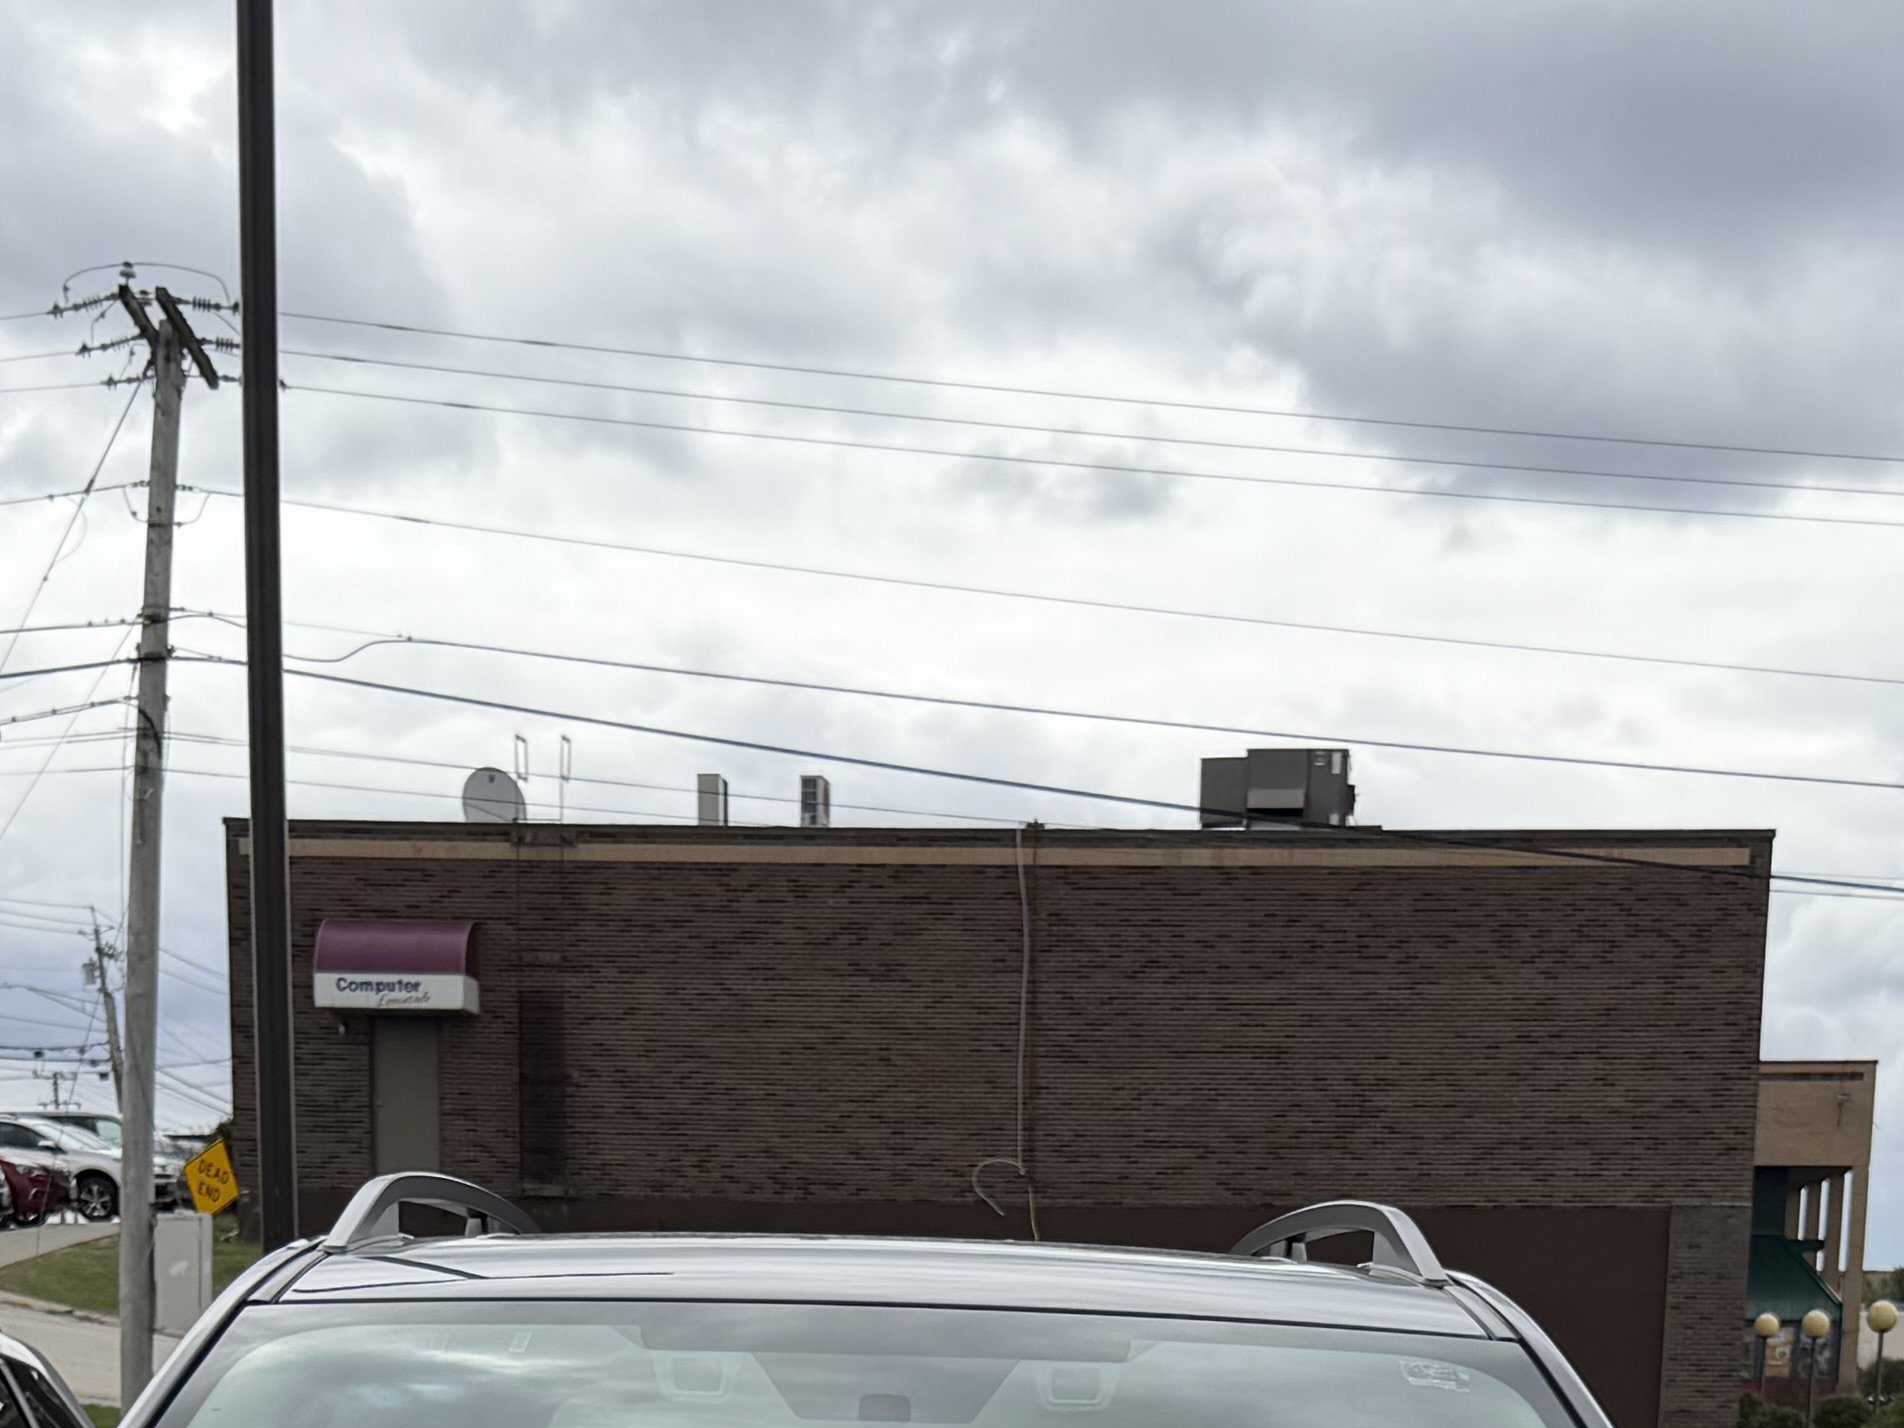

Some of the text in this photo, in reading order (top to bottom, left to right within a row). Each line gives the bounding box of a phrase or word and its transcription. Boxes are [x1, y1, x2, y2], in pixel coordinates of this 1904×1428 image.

[335, 977, 422, 994] Computer
[198, 1158, 230, 1185] DEAD
[197, 1181, 221, 1202] END
